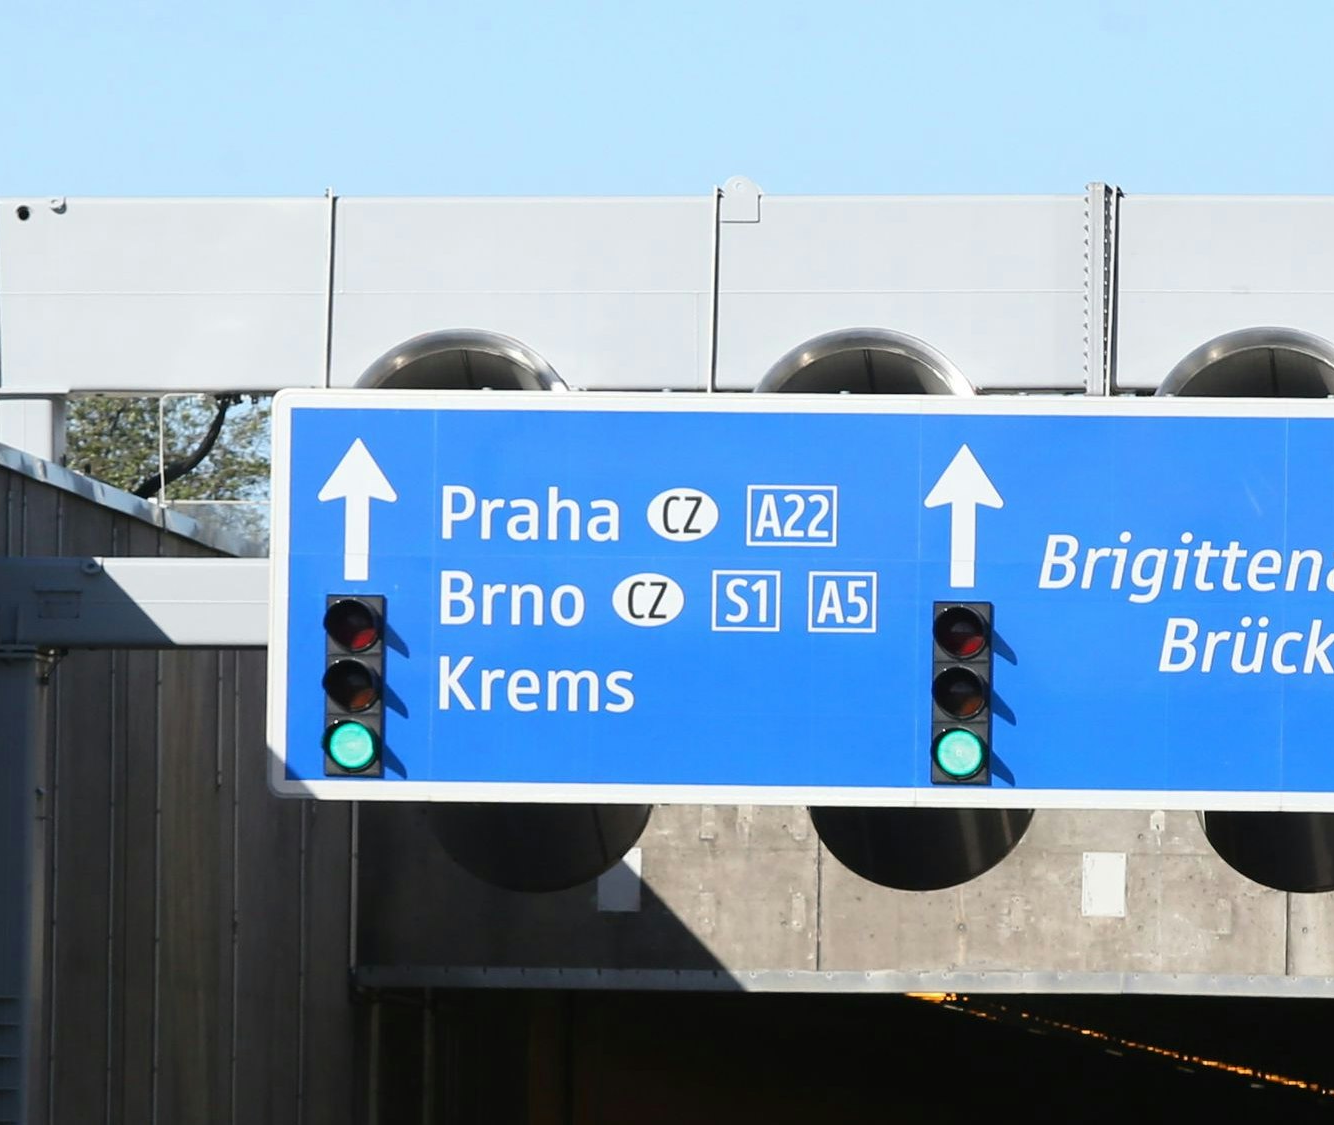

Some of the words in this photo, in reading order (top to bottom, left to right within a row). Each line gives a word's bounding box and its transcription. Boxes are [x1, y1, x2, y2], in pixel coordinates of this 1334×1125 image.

[441, 486, 620, 541] Praha
[663, 497, 701, 533] CZ
[755, 494, 829, 538] A22
[440, 571, 585, 626] Brno
[627, 582, 668, 618] CZ
[725, 579, 769, 623] S1
[817, 580, 868, 624] A5
[439, 656, 635, 712] Krems
